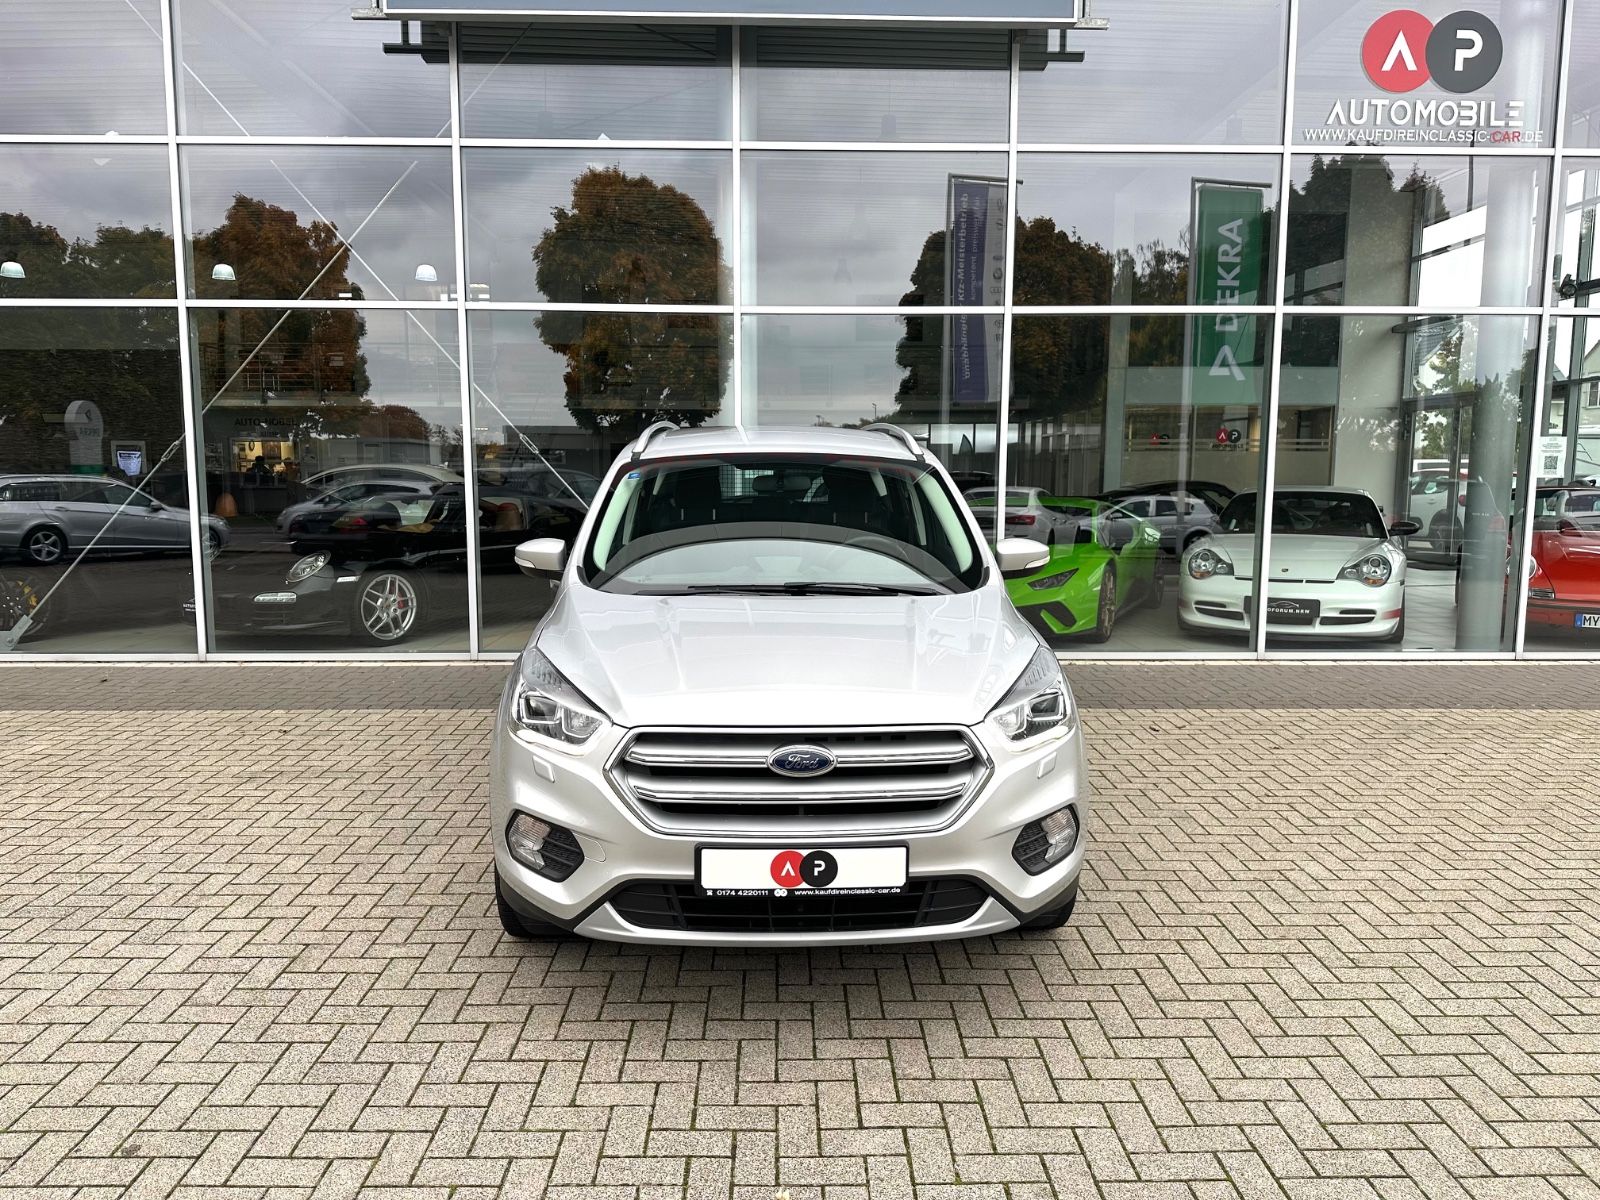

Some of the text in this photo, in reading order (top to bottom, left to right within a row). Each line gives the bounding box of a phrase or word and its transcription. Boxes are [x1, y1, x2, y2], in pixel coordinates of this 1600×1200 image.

[1326, 98, 1525, 127] AUTOMOBILE
[1304, 128, 1544, 143] WWW.KAUFDIREINCLASSIC-CAR.DE
[1216, 218, 1244, 332] DEKRA
[785, 753, 820, 769] Ford
